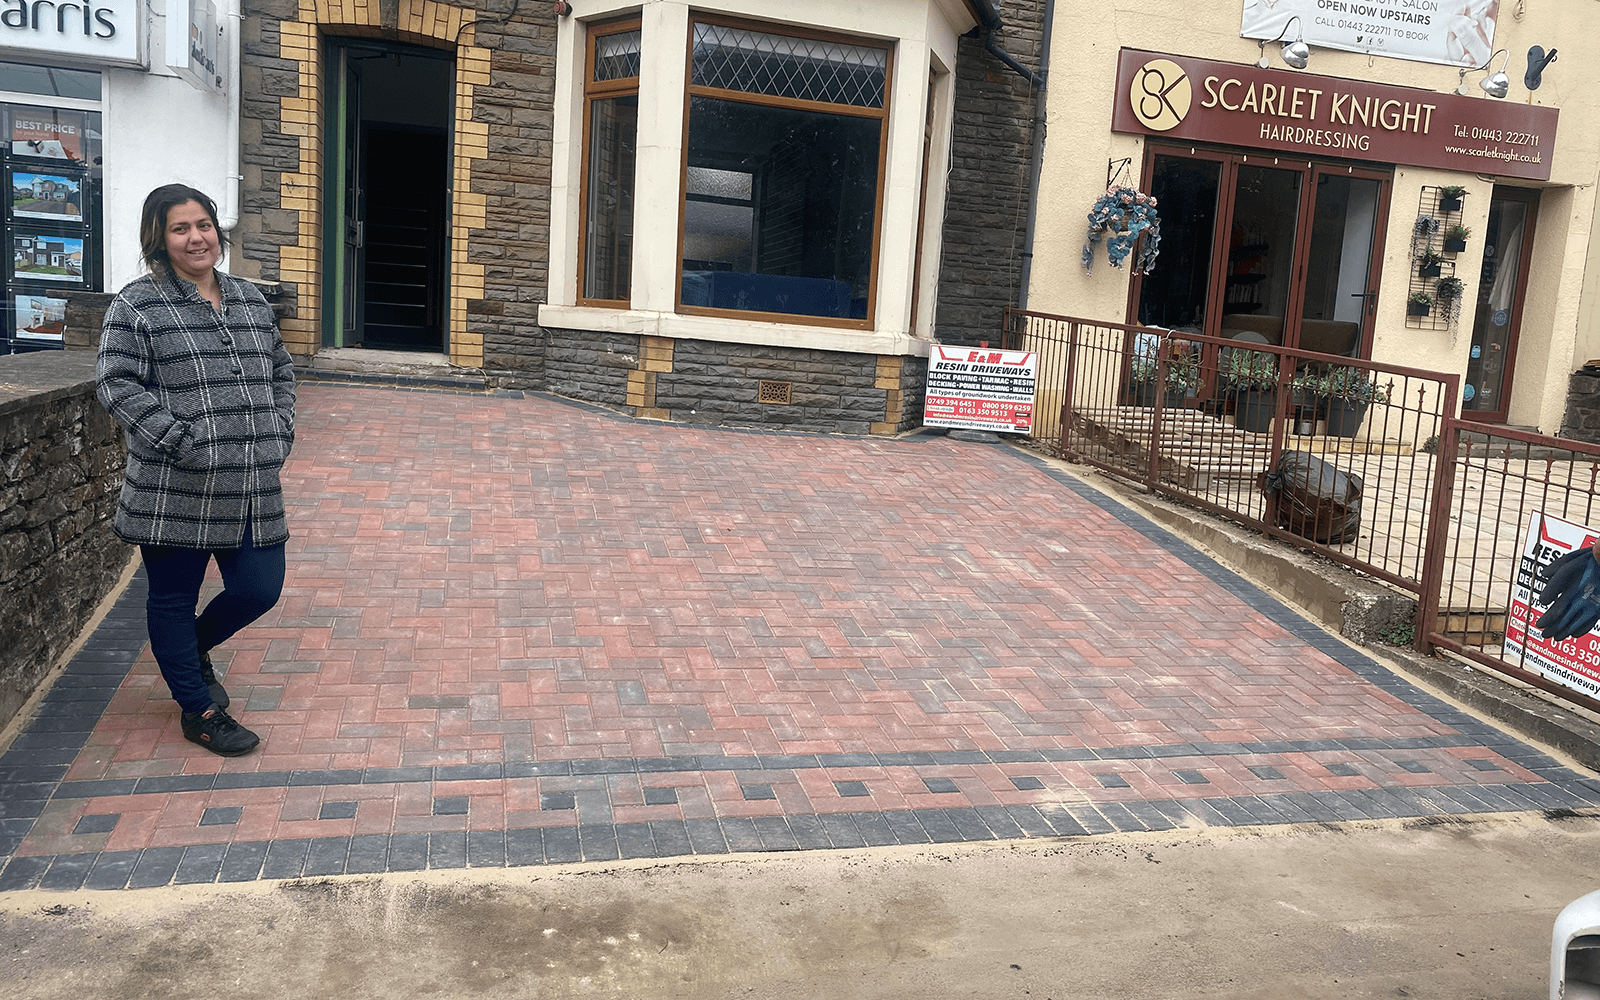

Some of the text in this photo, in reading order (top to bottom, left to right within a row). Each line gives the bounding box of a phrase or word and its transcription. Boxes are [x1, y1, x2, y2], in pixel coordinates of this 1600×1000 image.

[1317, 0, 1431, 25] OPEN NOW UPSTAIRS
[1402, 0, 1438, 12] SALON
[1315, 16, 1429, 41] CALL 01443 222711 TO BOOK
[1201, 75, 1436, 134] SCARLET KNIGHT
[15, 120, 76, 134] BEST PRICE
[1454, 124, 1540, 146] Tel: 01443 222711
[1260, 122, 1370, 152] HAIRDRESSING
[1444, 145, 1542, 164] www.scarletknight.co.uk
[967, 351, 1003, 364] E&M
[936, 362, 1032, 376] RESIN DRIVEWAYS
[928, 380, 956, 388] DECKING
[959, 382, 980, 390] POWER
[982, 384, 1010, 392] WASHING
[929, 372, 951, 380] BLOCK
[953, 374, 978, 382] PAVING
[982, 376, 1010, 384] TARMAC
[928, 398, 946, 406] 0749
[960, 400, 976, 408] 6451
[962, 392, 997, 400] groundwork
[998, 394, 1032, 402] undertaken
[976, 408, 990, 416] 350
[982, 402, 1000, 410] 0800
[1014, 404, 1031, 412] 6259
[1532, 542, 1565, 562] RES
[1521, 558, 1549, 580] BLOC
[1519, 572, 1547, 591] DECKI
[1518, 589, 1529, 600] All
[1513, 605, 1534, 622] 0749
[1551, 635, 1577, 657] 0163
[1578, 648, 1600, 667] 350
[1506, 641, 1600, 695] www.andmresindriveway
